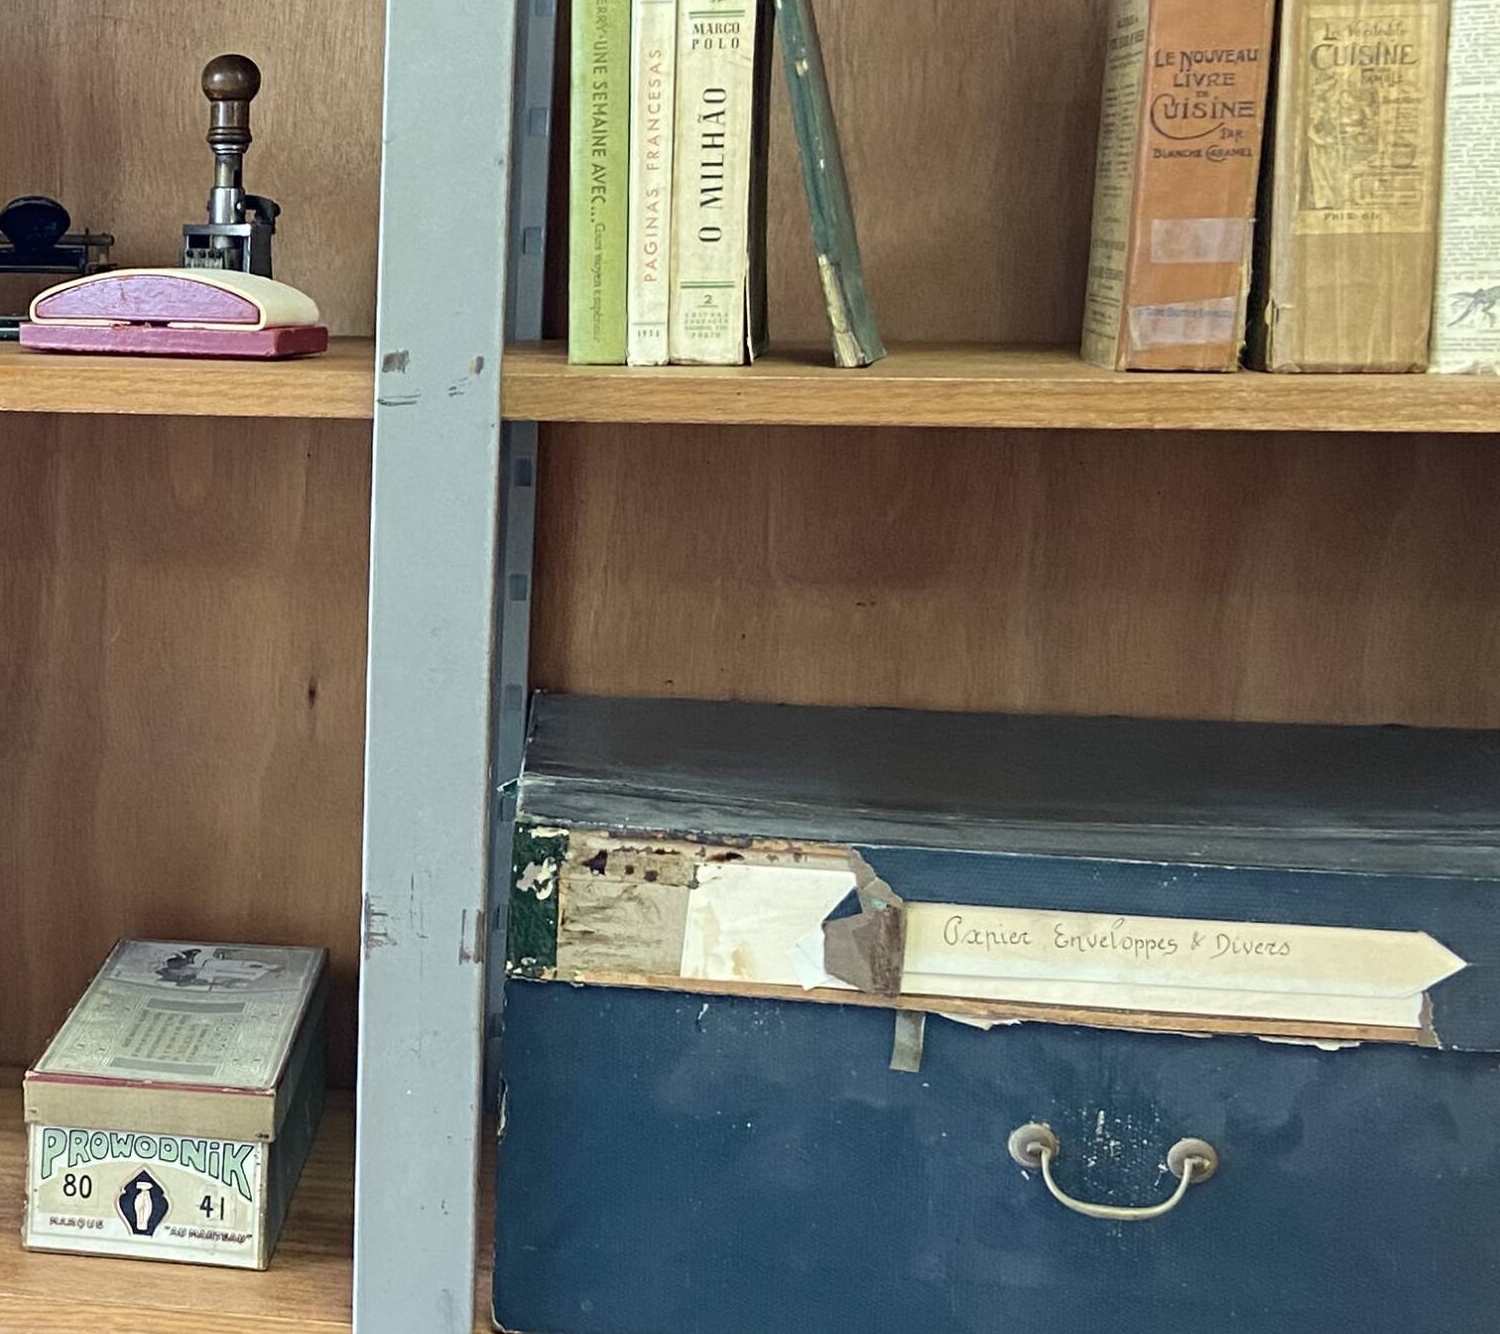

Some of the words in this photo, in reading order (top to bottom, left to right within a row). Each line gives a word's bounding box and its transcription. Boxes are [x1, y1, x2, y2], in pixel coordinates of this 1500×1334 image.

[692, 22, 740, 35] MARCO
[692, 37, 740, 51] POLO
[592, 40, 609, 75] UNE
[1154, 48, 1176, 68] LE
[1180, 49, 1260, 73] NOUVEAU
[1310, 40, 1420, 71] CUISINE
[591, 81, 608, 157] SEMAINE
[646, 49, 663, 171] FRANCESAS
[697, 88, 728, 210] MILHÃO
[590, 164, 607, 223] AVEC...
[643, 188, 660, 282] PAGINAS
[697, 225, 723, 243] O
[704, 294, 712, 304] 2
[943, 915, 1032, 952] Papier
[1054, 917, 1179, 959] Enveloppes
[1209, 932, 1292, 960] Divers
[62, 1173, 93, 1199] 80
[199, 1195, 224, 1221] 41
